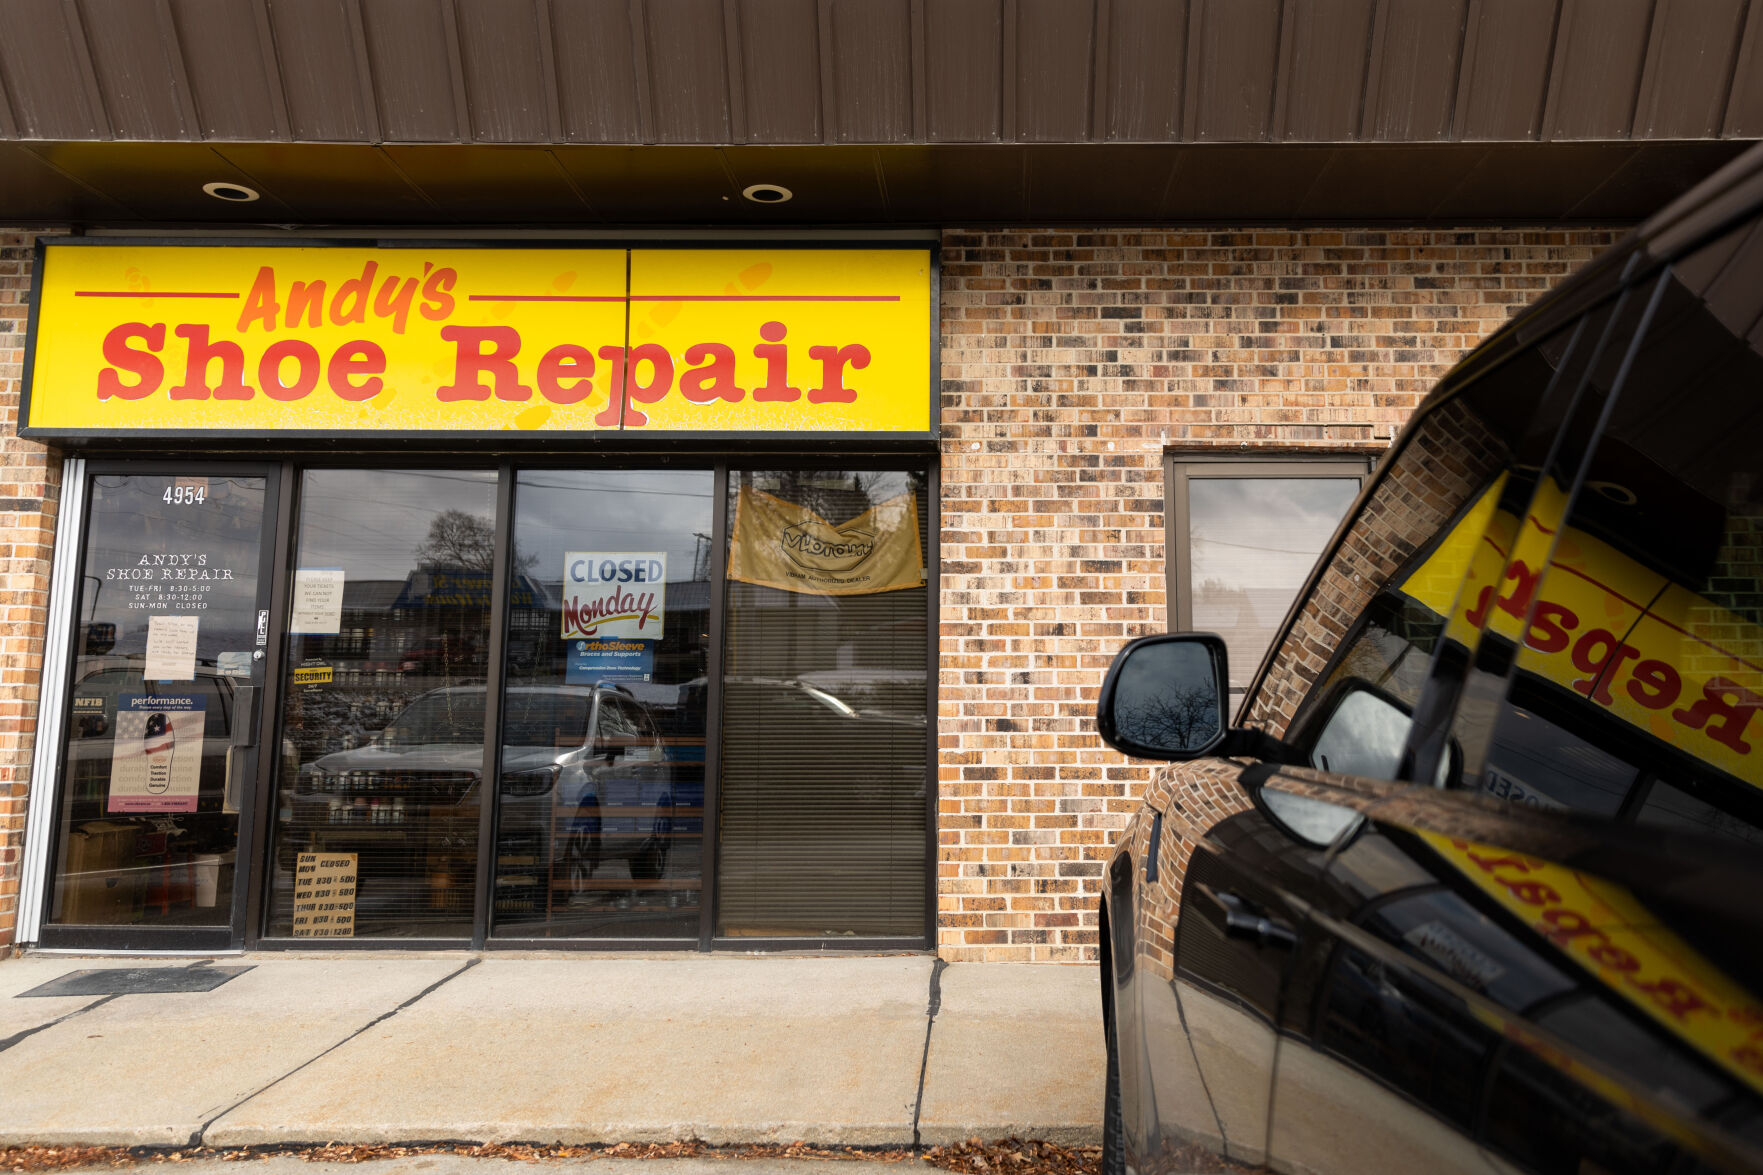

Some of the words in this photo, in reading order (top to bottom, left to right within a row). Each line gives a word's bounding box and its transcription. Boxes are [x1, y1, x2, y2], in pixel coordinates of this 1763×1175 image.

[236, 260, 458, 334] Andy's
[97, 322, 387, 402] Shoe
[436, 321, 871, 427] Repair
[163, 486, 204, 504] 4954
[138, 554, 207, 566] ANDY'S
[106, 568, 153, 580] SHOE
[161, 568, 234, 580] REPAIR
[570, 559, 663, 582] CLOSED
[564, 585, 658, 635] Monday
[295, 672, 331, 681] SECURITY
[75, 698, 102, 706] NFIB
[131, 696, 193, 707] performance.
[298, 878, 312, 886] TUE
[296, 891, 312, 899] WED
[296, 904, 316, 912] THUR
